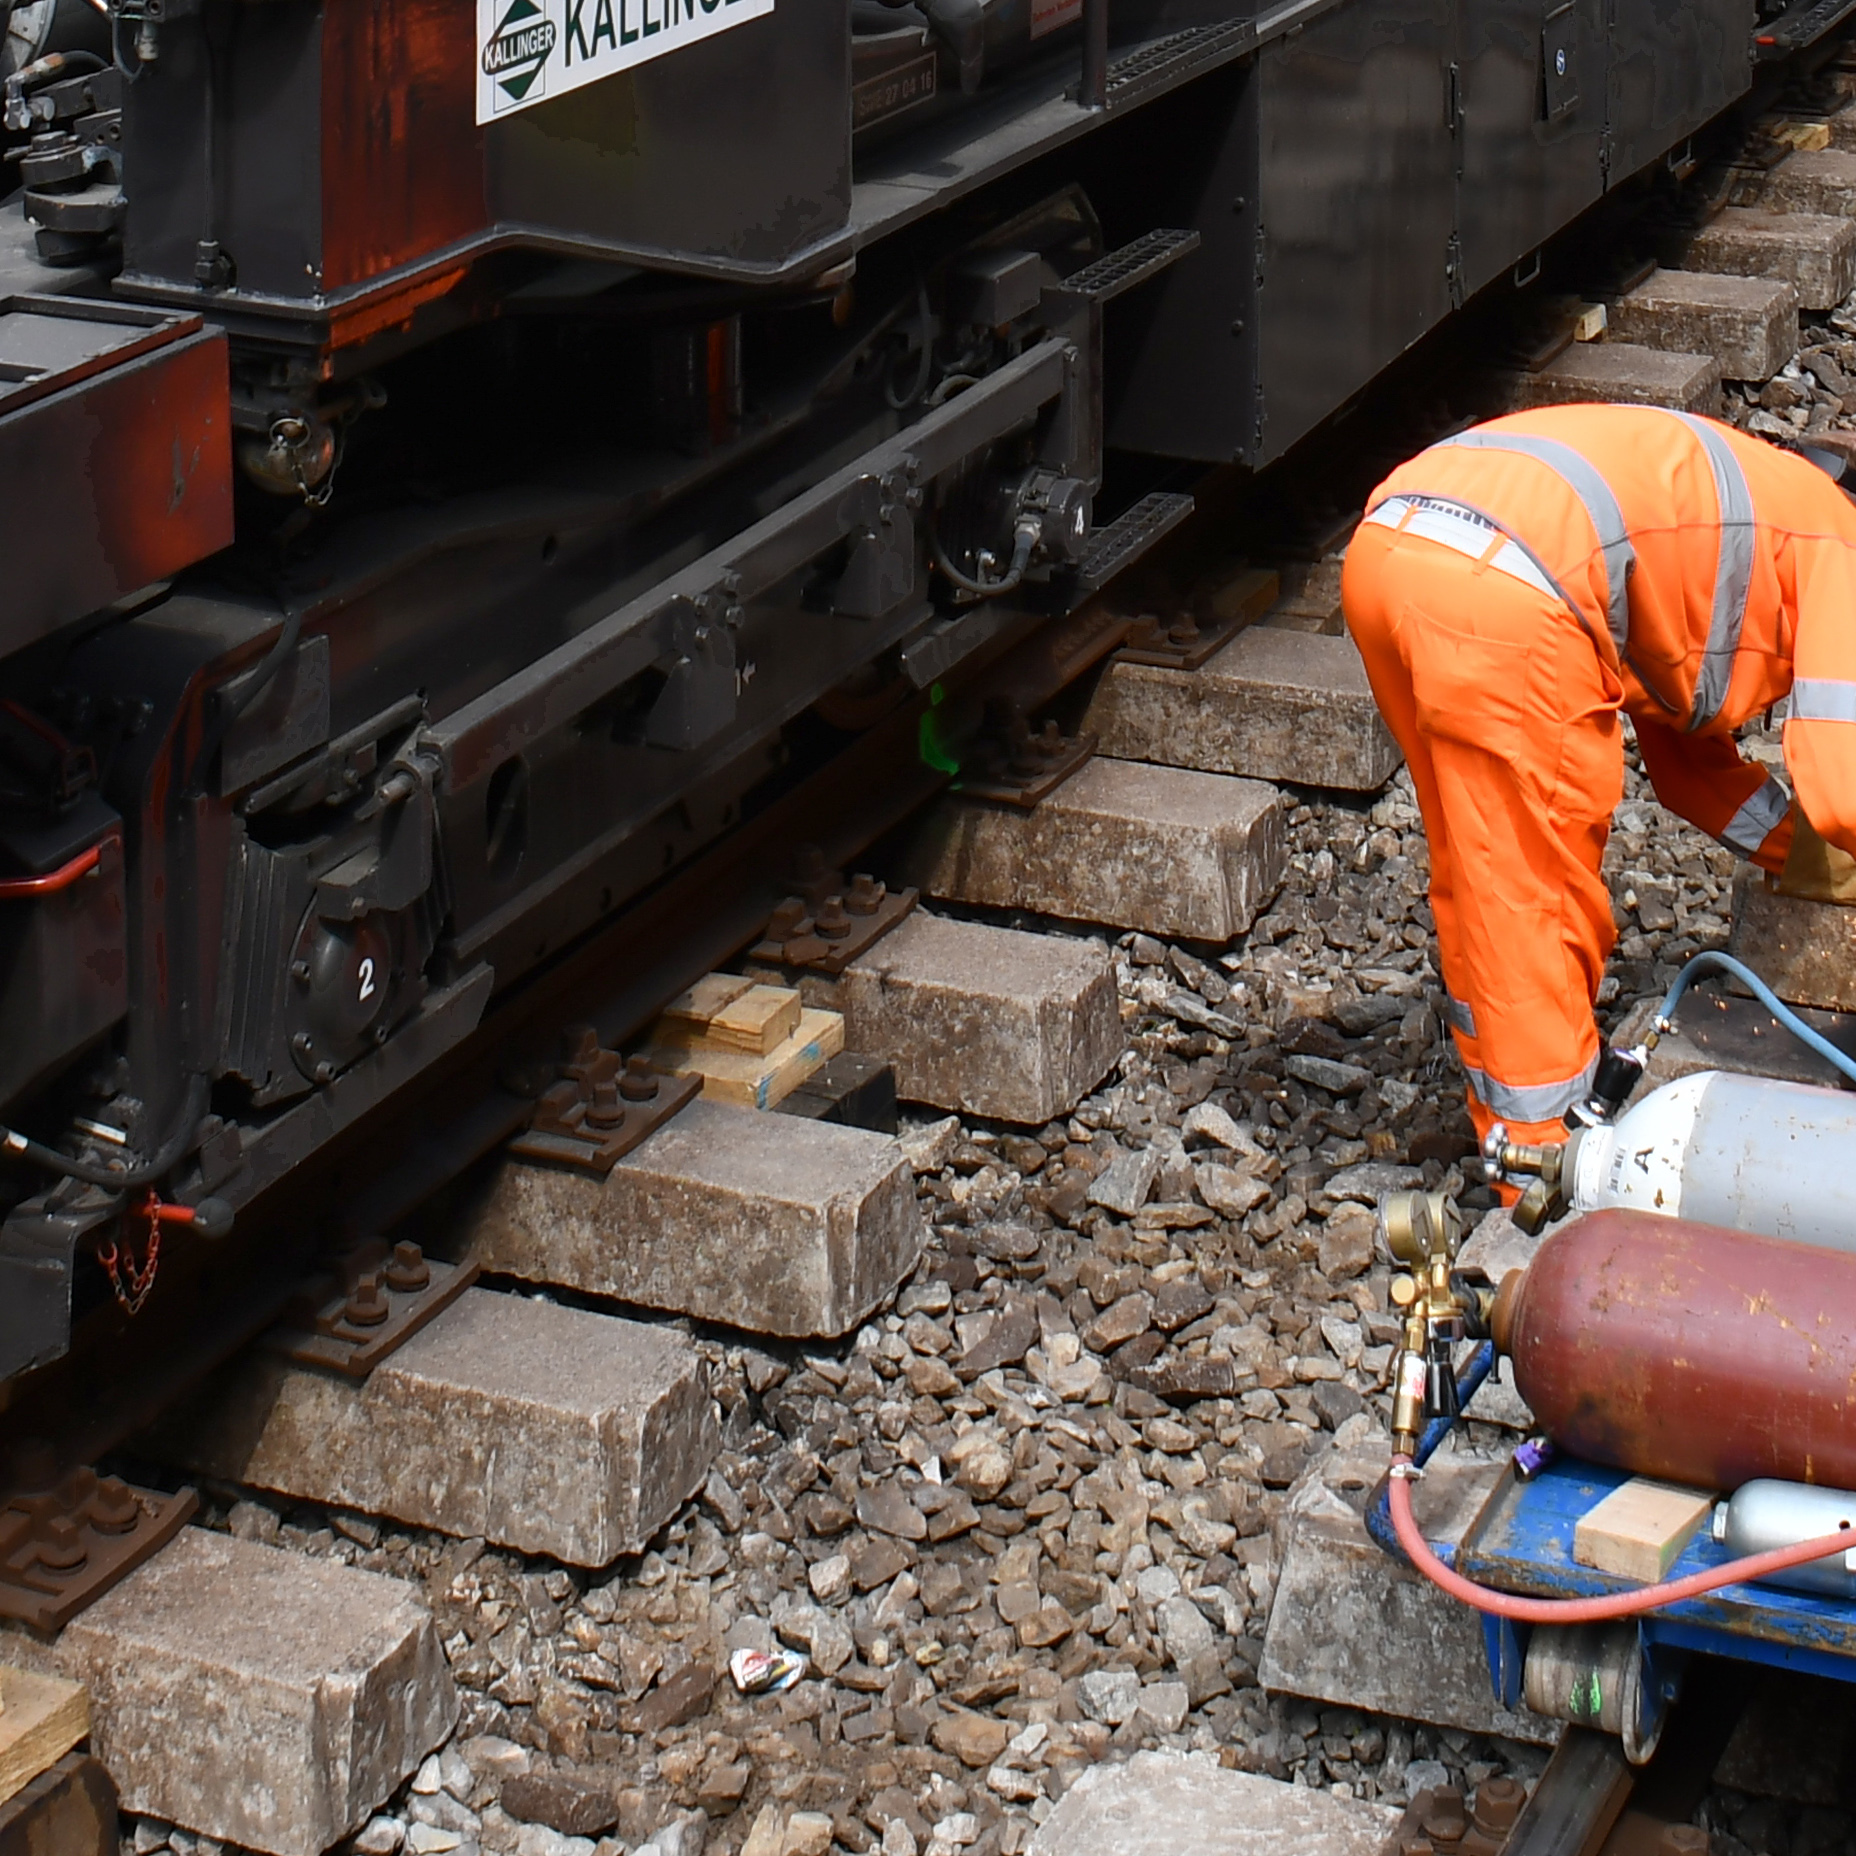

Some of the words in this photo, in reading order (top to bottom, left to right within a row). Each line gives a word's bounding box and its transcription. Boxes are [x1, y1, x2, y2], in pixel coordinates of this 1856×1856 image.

[484, 23, 554, 72] KALLINGER
[920, 70, 932, 90] 16
[356, 957, 375, 1002] 2
